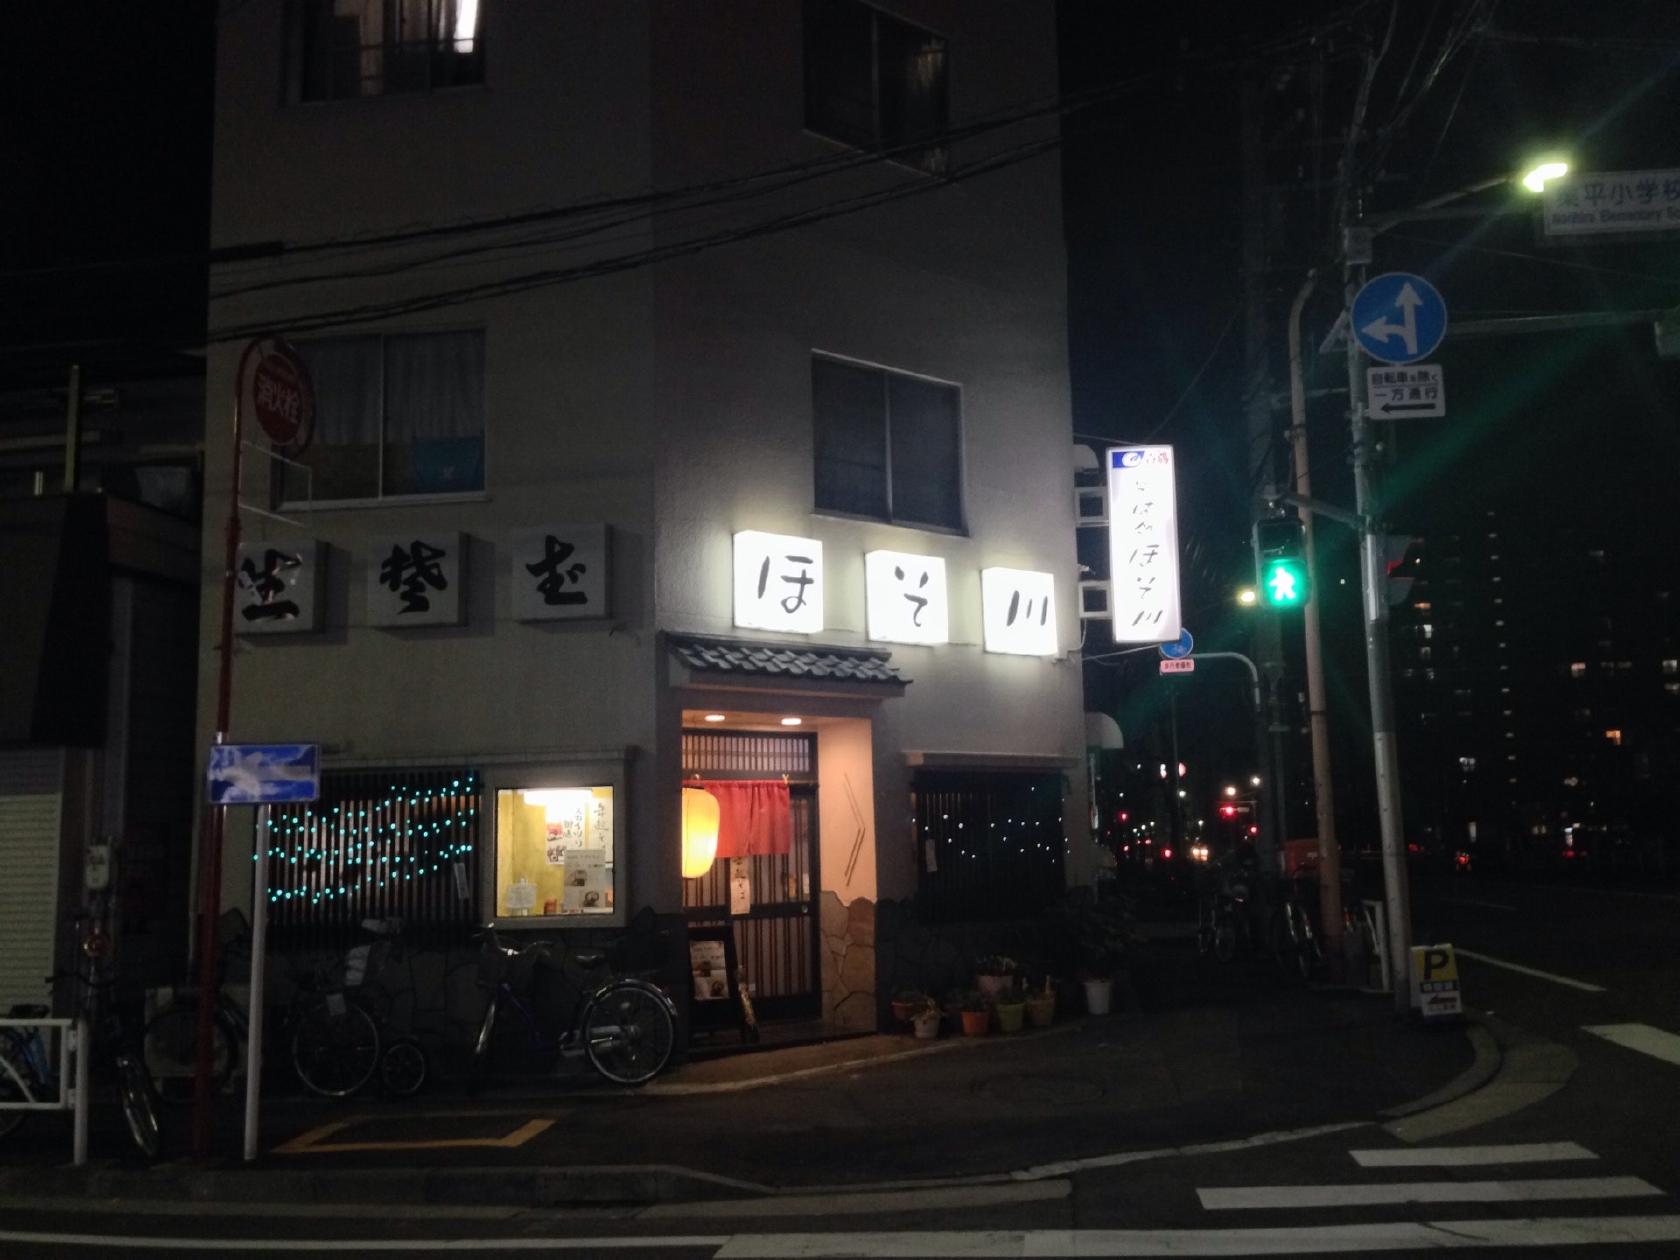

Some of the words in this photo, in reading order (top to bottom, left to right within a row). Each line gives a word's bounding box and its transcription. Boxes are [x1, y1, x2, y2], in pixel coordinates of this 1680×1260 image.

[257, 374, 298, 423] 消火栓
[1375, 387, 1437, 401] 一方通行
[757, 555, 1048, 627] ほそ川
[1424, 950, 1449, 980] P
